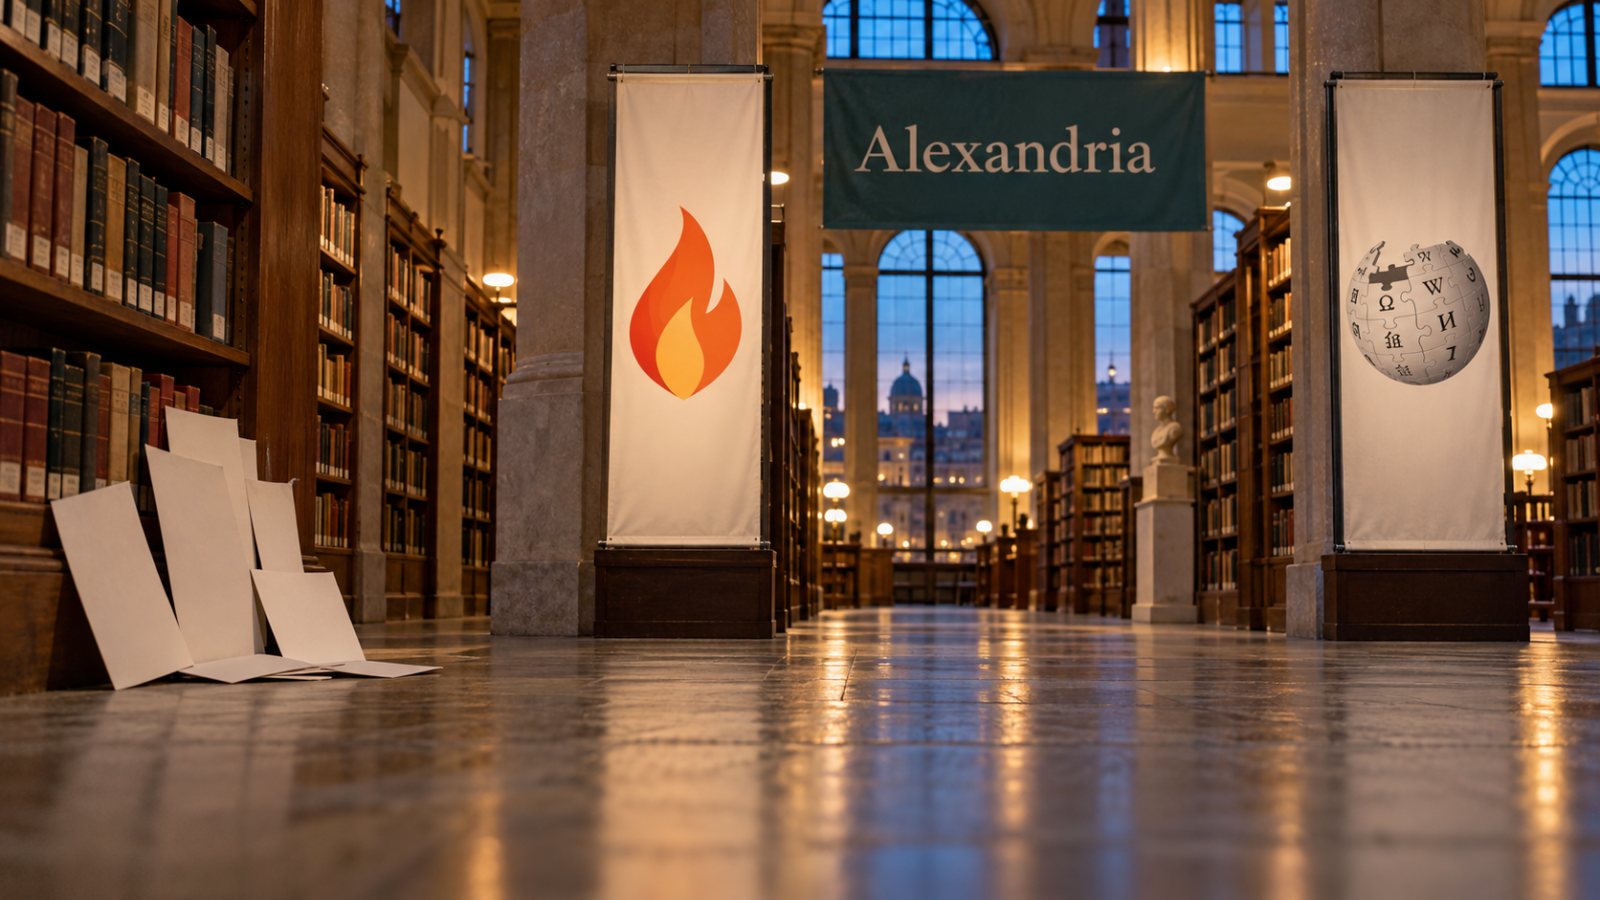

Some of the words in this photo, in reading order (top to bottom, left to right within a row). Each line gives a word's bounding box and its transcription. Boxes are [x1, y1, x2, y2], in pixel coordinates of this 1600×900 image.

[854, 124, 1156, 174] Alexandria
[1422, 277, 1443, 295] W
[1379, 295, 1395, 312] Ω
[1437, 311, 1457, 332] И
